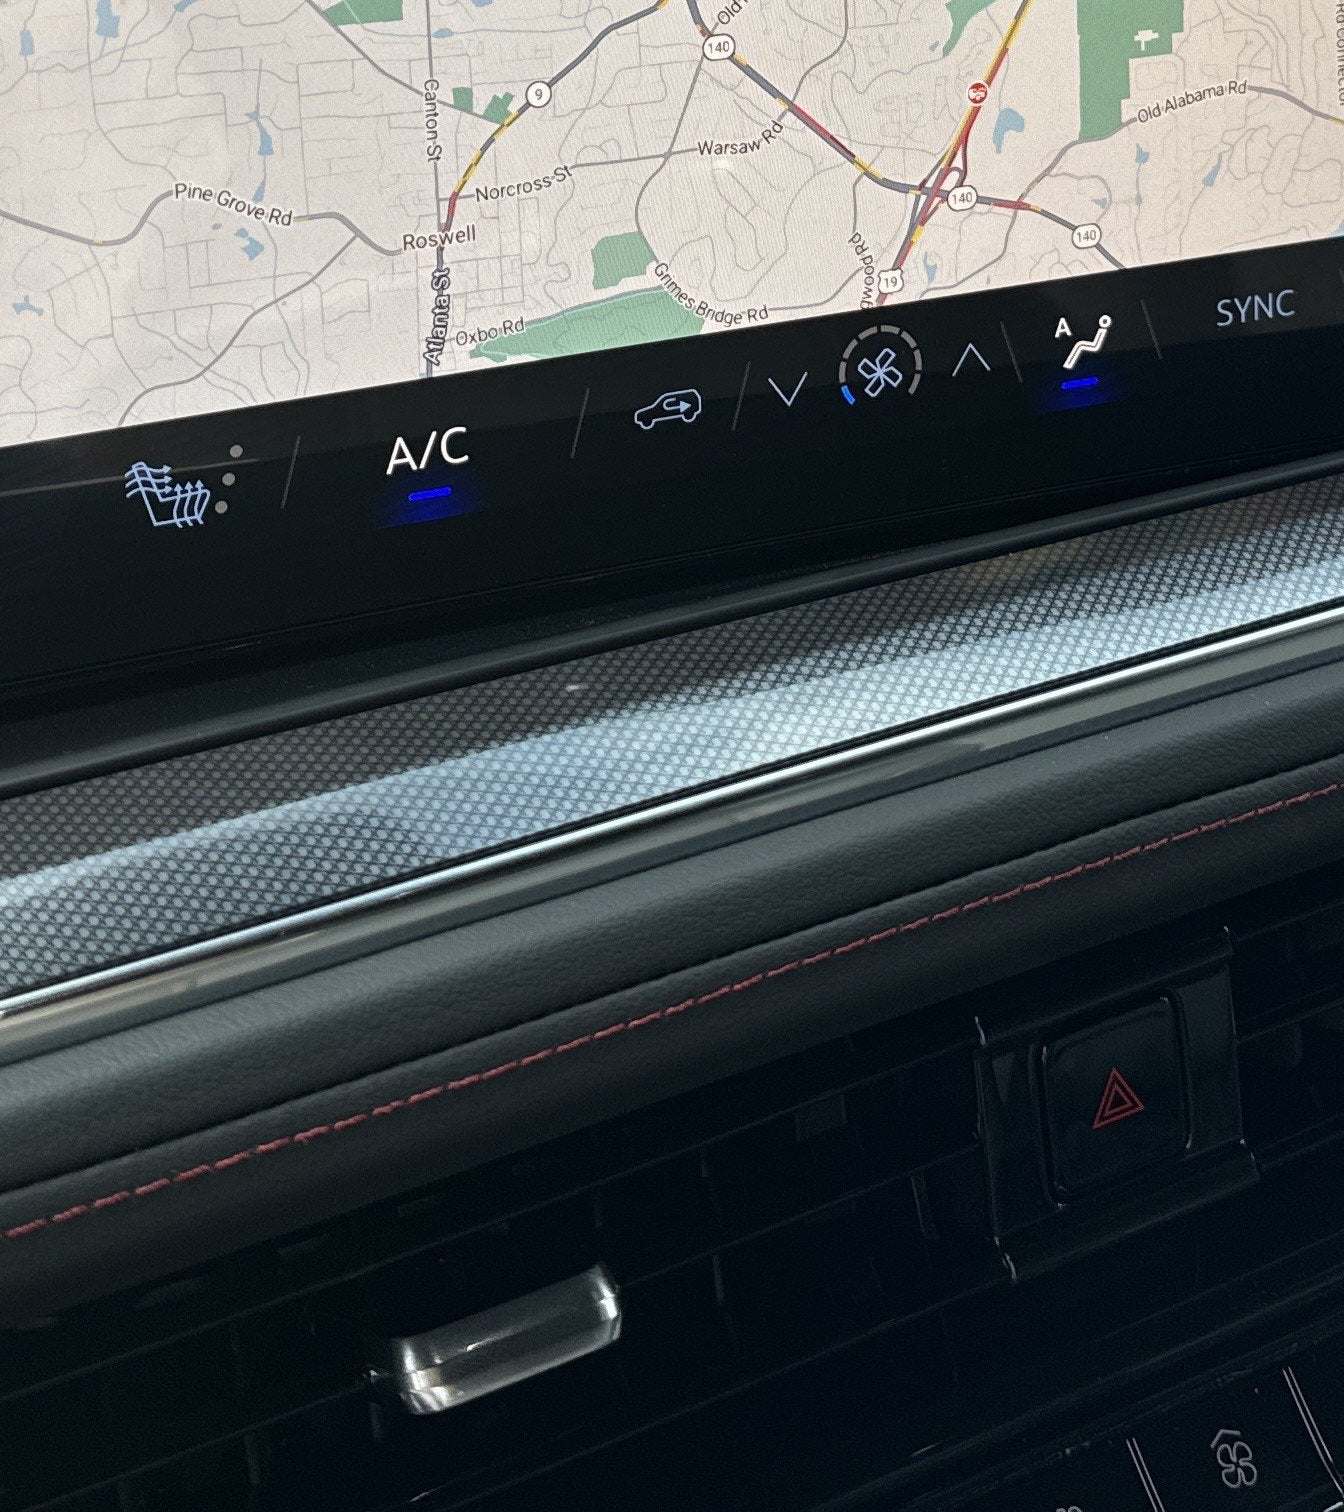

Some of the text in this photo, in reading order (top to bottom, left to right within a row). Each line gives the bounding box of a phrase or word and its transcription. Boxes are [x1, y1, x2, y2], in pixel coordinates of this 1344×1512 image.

[708, 40, 730, 54] 140
[424, 78, 442, 163] Canton St
[1138, 81, 1248, 123] Old Alabama Rd
[697, 121, 784, 155] Warsaw Rd
[475, 166, 573, 203] Norcross St
[952, 192, 973, 205] 140
[174, 183, 293, 227] Pine Grove Rd
[403, 224, 476, 252] Roswell
[848, 232, 869, 255] Rd
[1076, 230, 1097, 242] 140
[654, 262, 768, 327] Grimes Bridge Rd
[1216, 290, 1296, 329] SYNC
[423, 266, 451, 365] Atlanta St
[455, 317, 524, 346] Oxbo Rd
[386, 426, 470, 475] A/C
